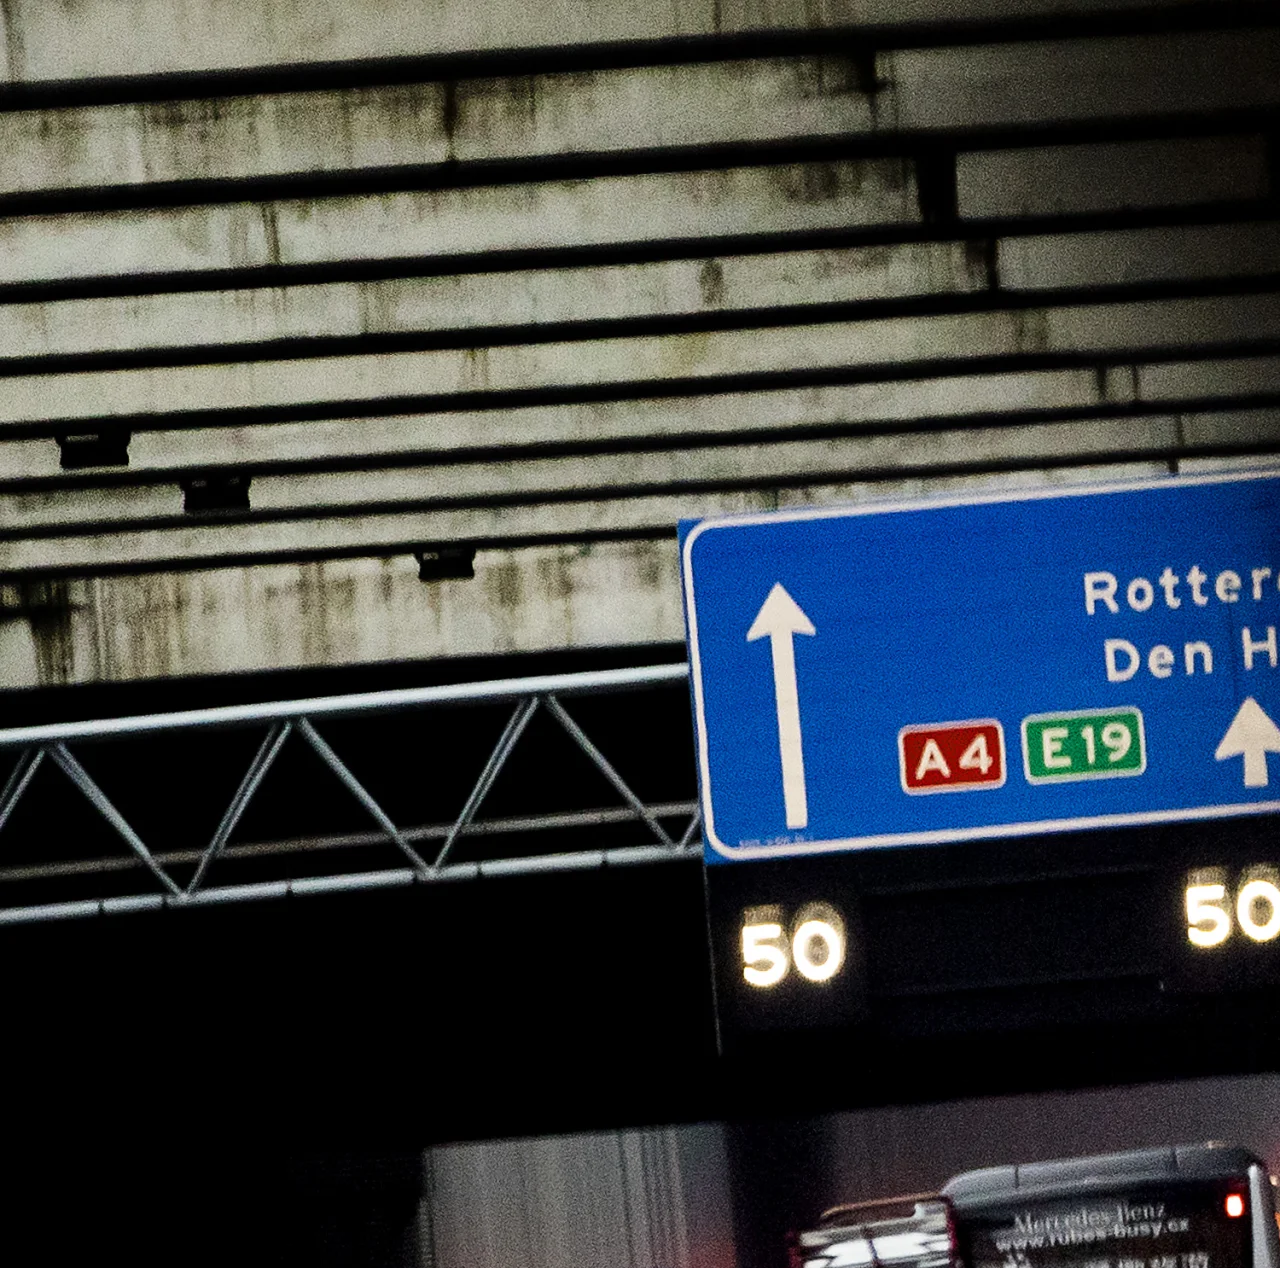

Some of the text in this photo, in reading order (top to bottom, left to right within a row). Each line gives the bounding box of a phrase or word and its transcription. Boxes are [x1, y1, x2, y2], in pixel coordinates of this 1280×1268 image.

[1103, 638, 1214, 683] Den
[915, 712, 1133, 781] A4 E19
[740, 920, 844, 988] 50
